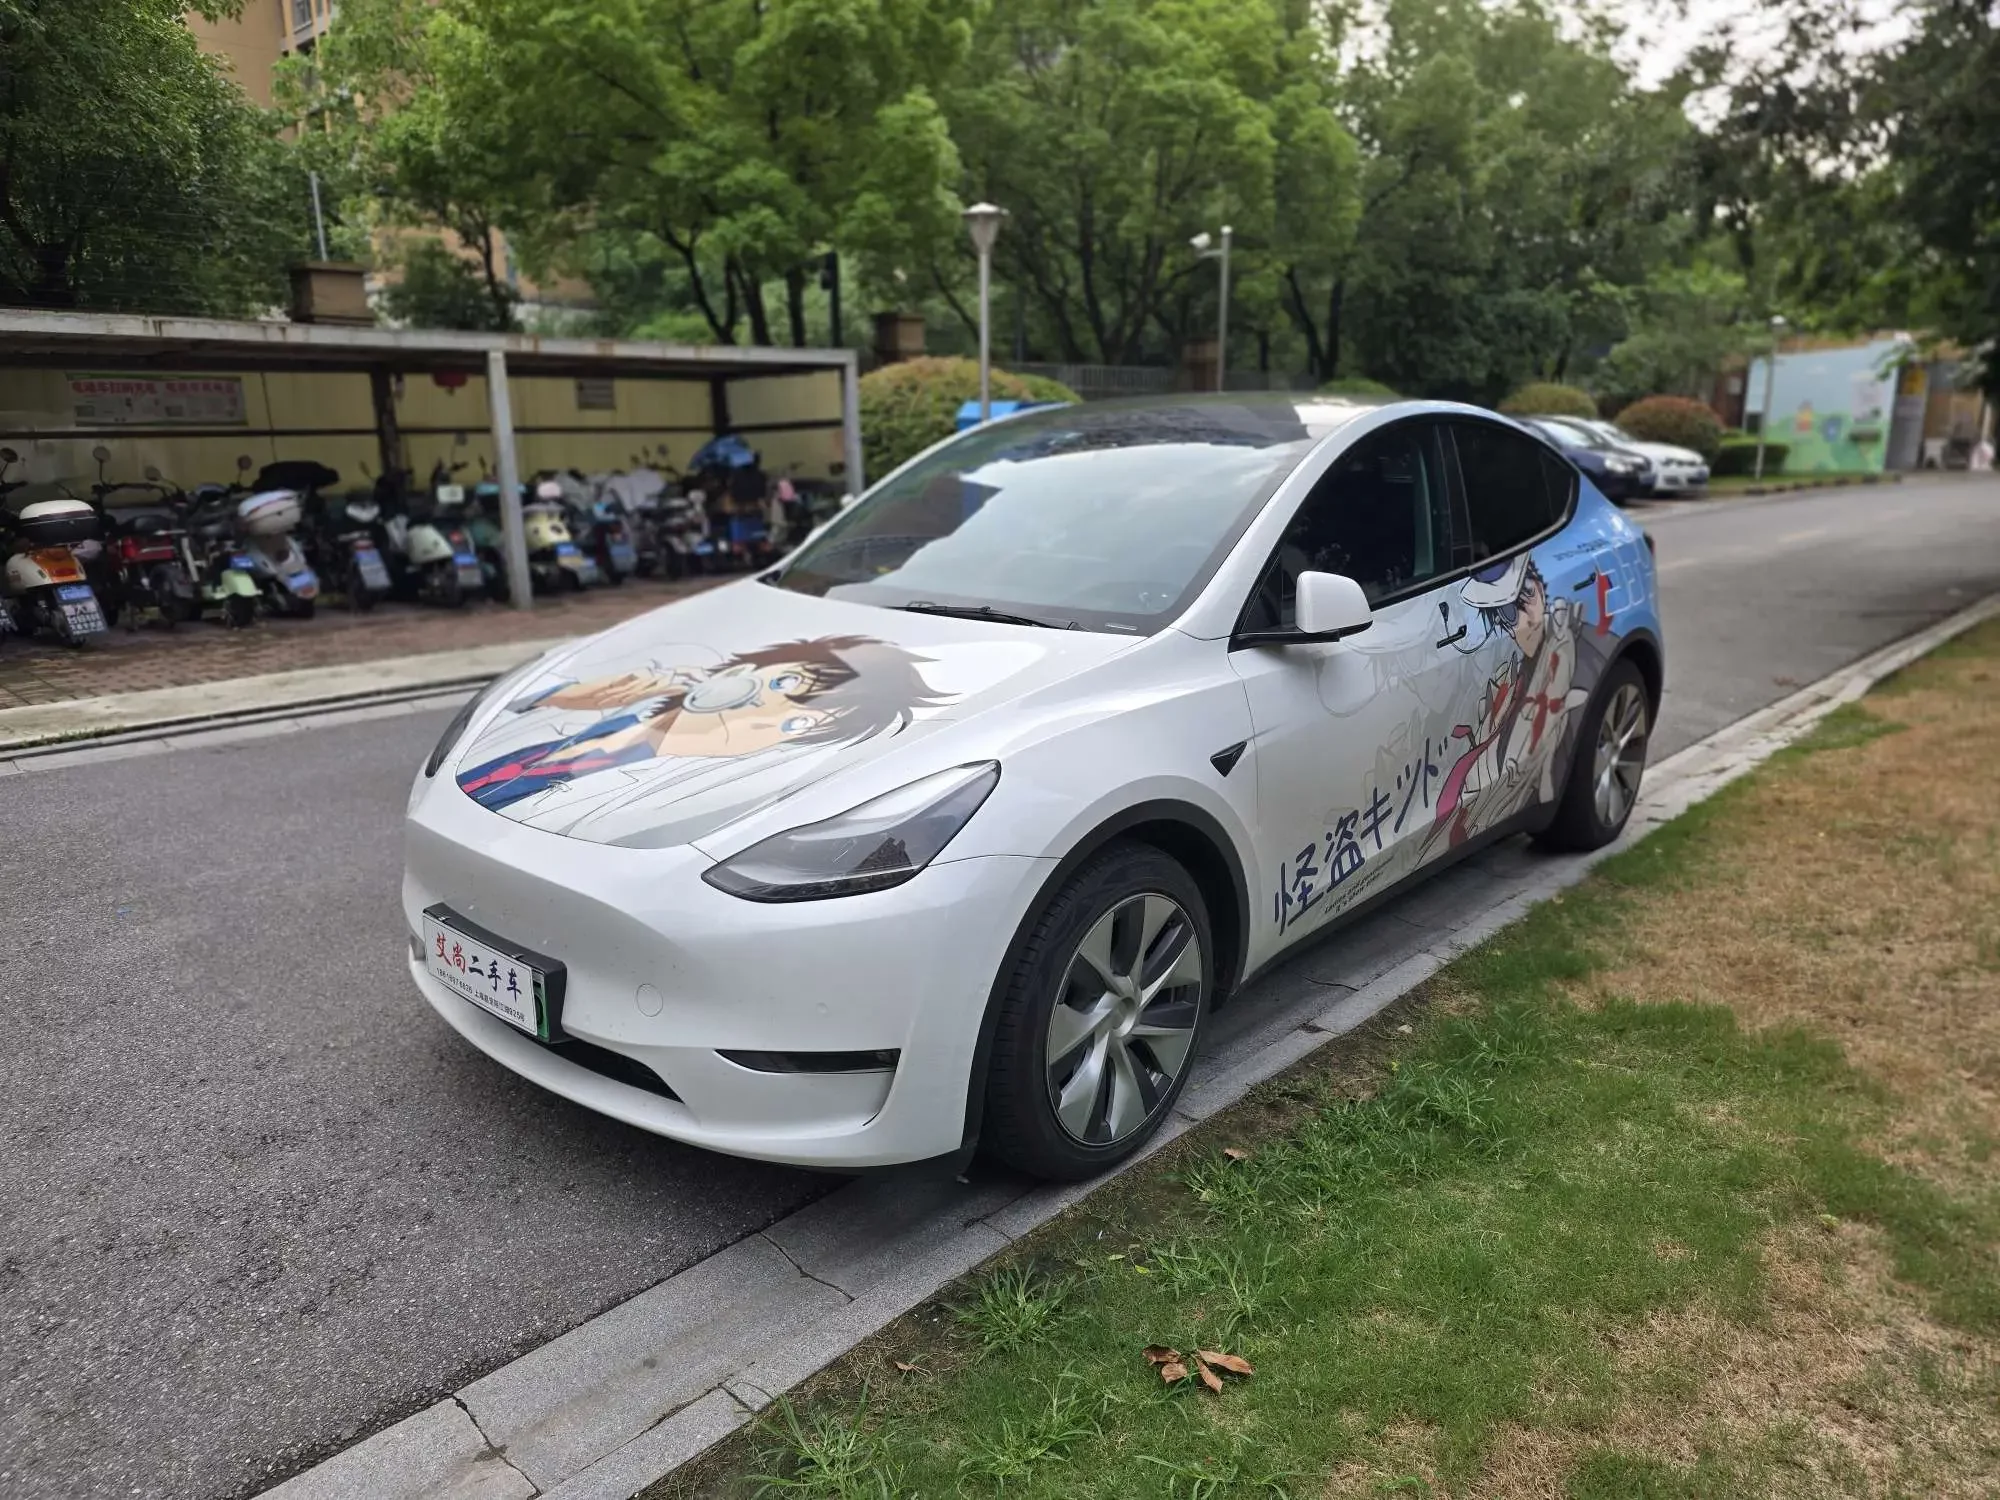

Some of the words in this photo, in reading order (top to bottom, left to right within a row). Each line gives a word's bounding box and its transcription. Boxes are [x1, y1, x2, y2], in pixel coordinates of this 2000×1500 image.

[435, 931, 523, 1003] 艾尚二手车
